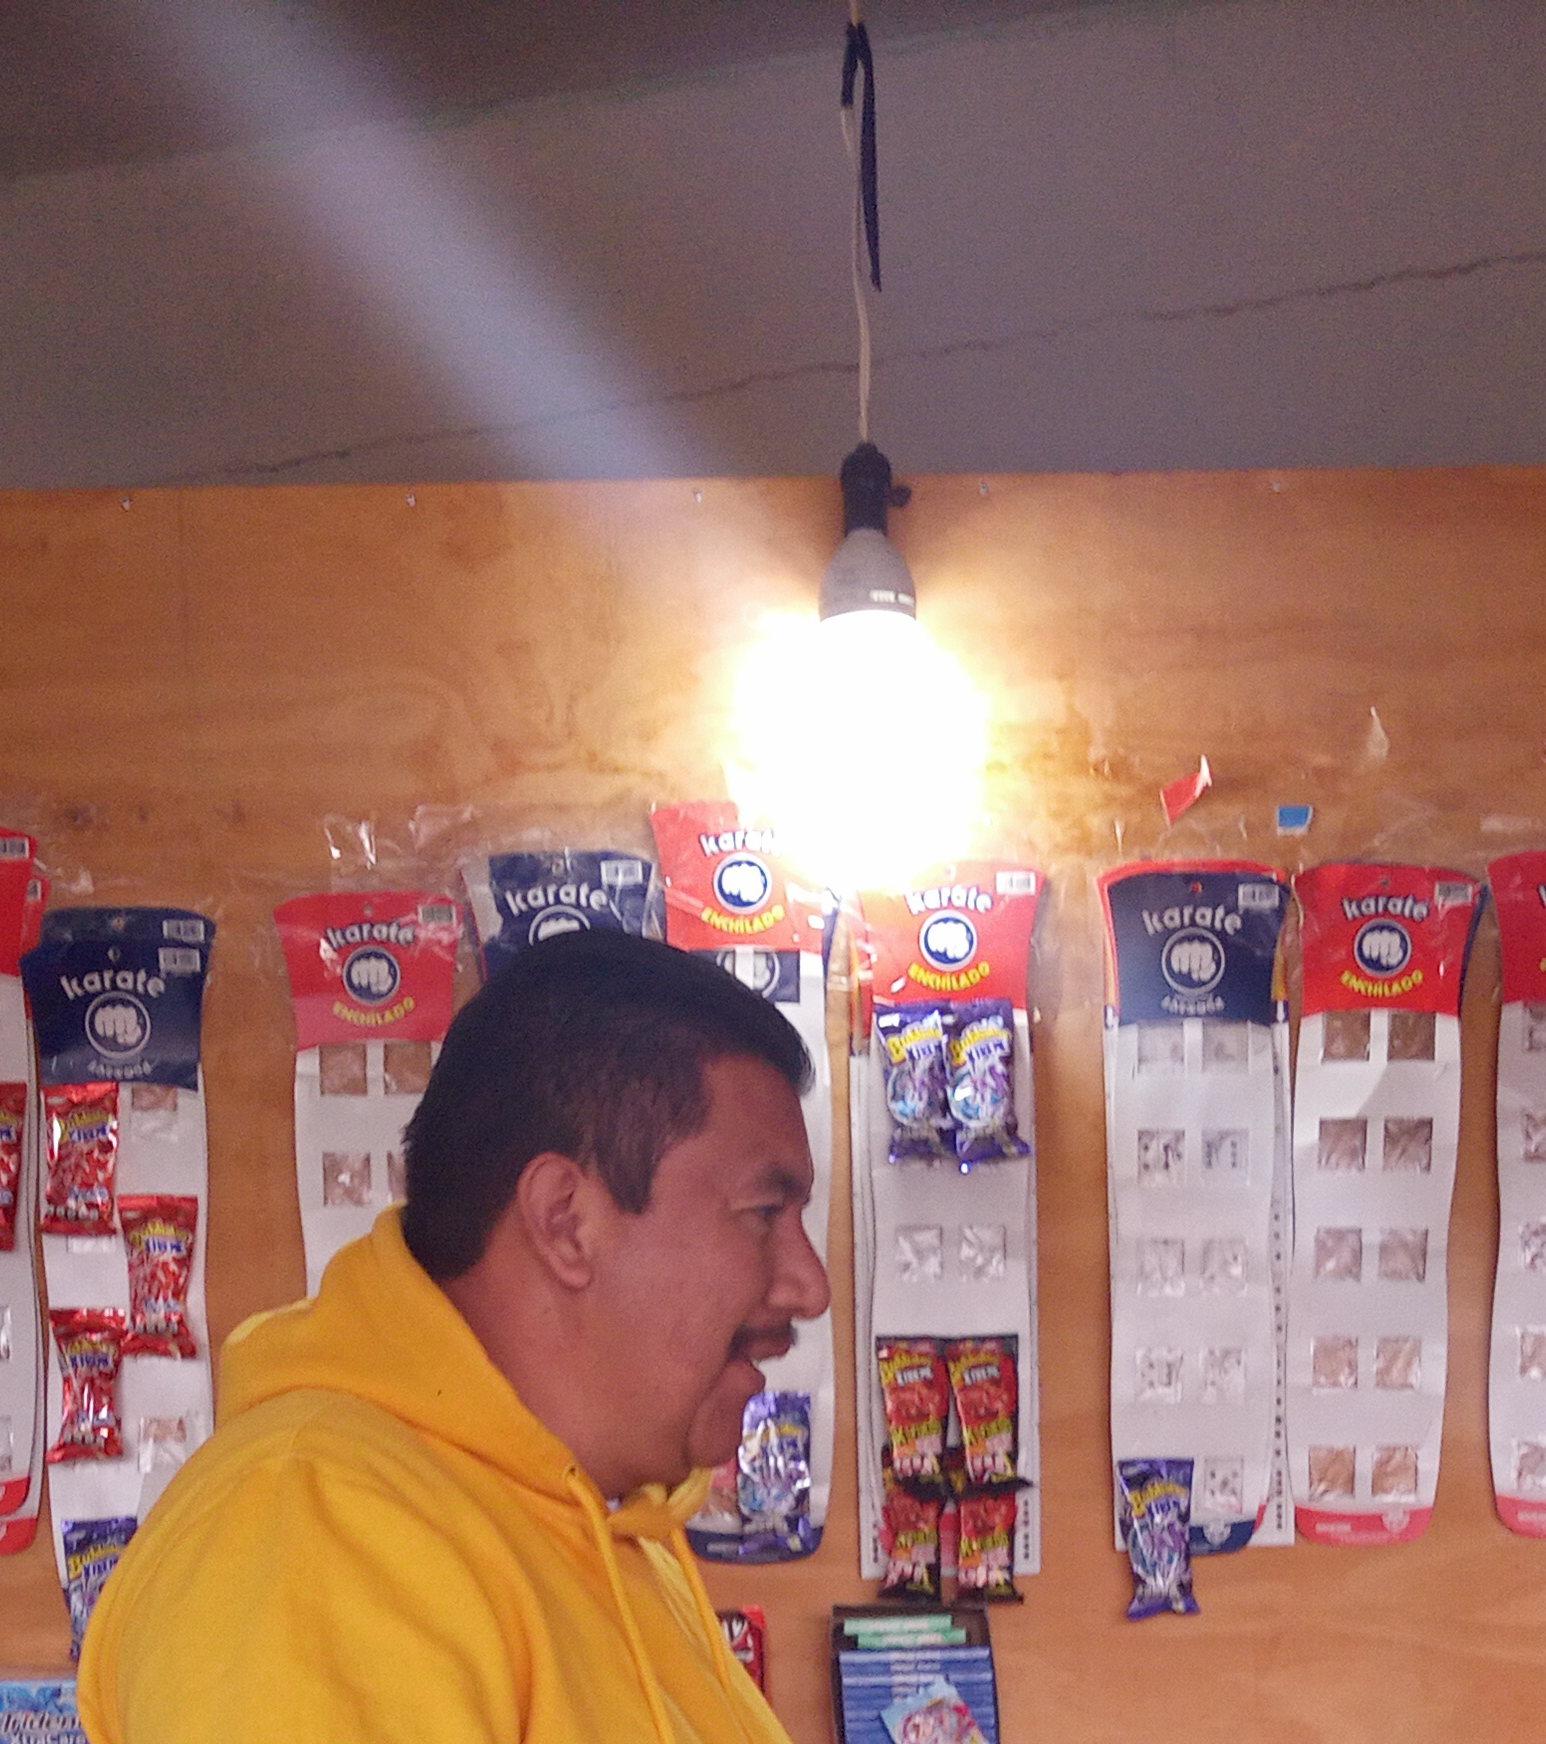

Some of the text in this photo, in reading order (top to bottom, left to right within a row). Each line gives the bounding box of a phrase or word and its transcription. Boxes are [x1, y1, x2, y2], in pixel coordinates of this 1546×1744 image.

[700, 830, 784, 857] karat
[505, 882, 607, 917] karate
[904, 885, 993, 915] karate
[1342, 892, 1429, 922] karate
[701, 904, 785, 934] ENCHILADO
[1143, 904, 1242, 936] karate
[325, 921, 415, 950] karate
[60, 968, 165, 1000] karate
[908, 961, 990, 992] ENCHILADO
[1340, 969, 1423, 999] ENCHILADO
